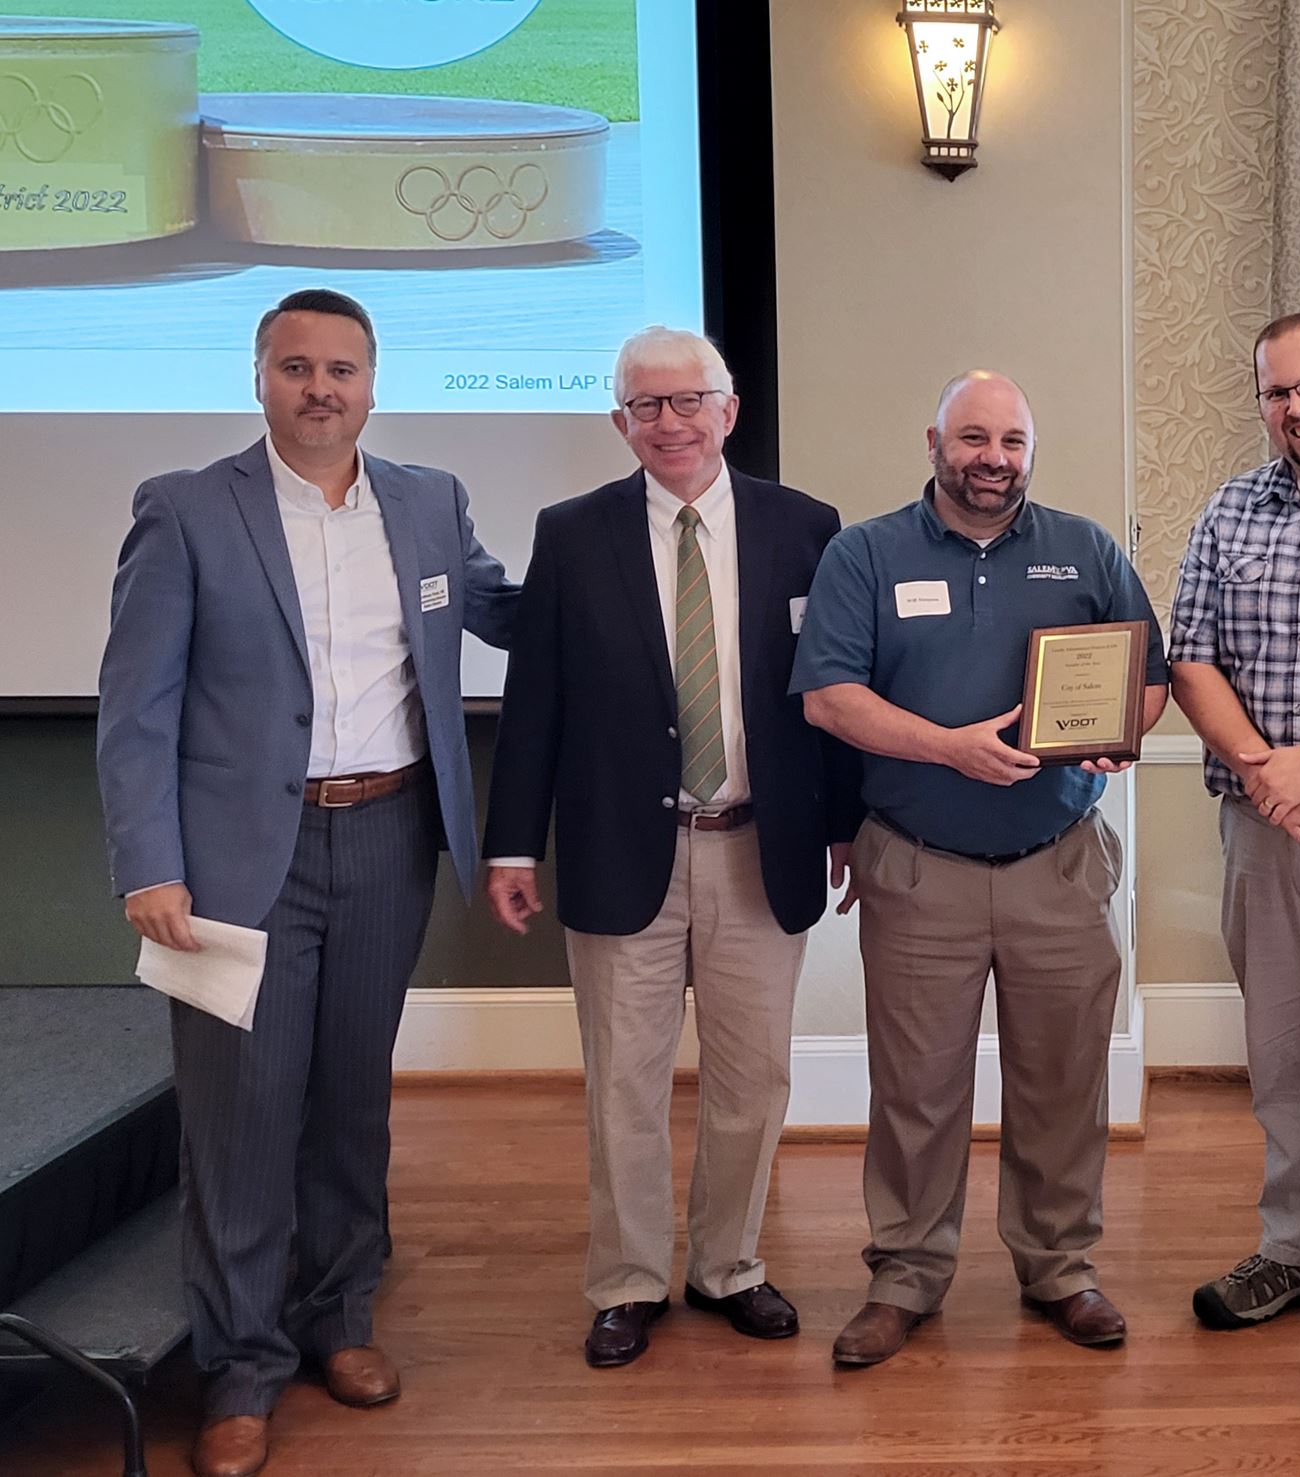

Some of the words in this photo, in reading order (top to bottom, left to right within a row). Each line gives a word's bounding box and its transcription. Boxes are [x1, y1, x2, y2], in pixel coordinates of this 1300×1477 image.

[52, 189, 127, 213] 2022
[444, 374, 489, 390] 2022
[495, 374, 552, 390] Salem
[559, 375, 597, 390] LAP
[1056, 717, 1098, 731] VDOT
